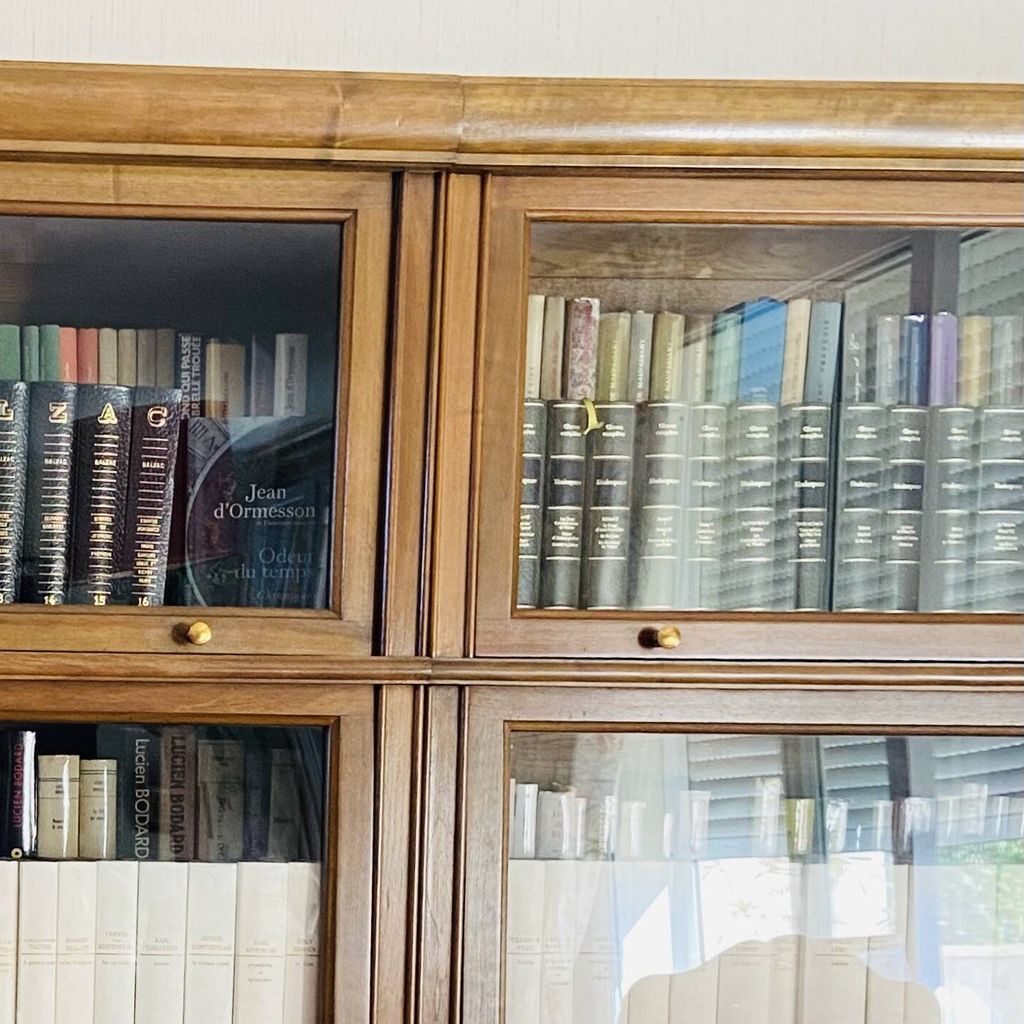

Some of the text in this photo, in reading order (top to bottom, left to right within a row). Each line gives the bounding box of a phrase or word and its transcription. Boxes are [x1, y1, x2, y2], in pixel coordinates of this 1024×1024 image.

[181, 335, 191, 369] PASSE
[245, 484, 286, 502] Jean
[214, 502, 316, 519] d'Ormesson
[259, 547, 312, 564] Odeur
[236, 563, 256, 579] du
[94, 594, 106, 606] 15
[138, 596, 150, 606] 16
[12, 743, 23, 828] LUCIEN BODARD
[134, 738, 150, 859] Lucien BODARD
[170, 735, 186, 854] LUCIEN BODARD
